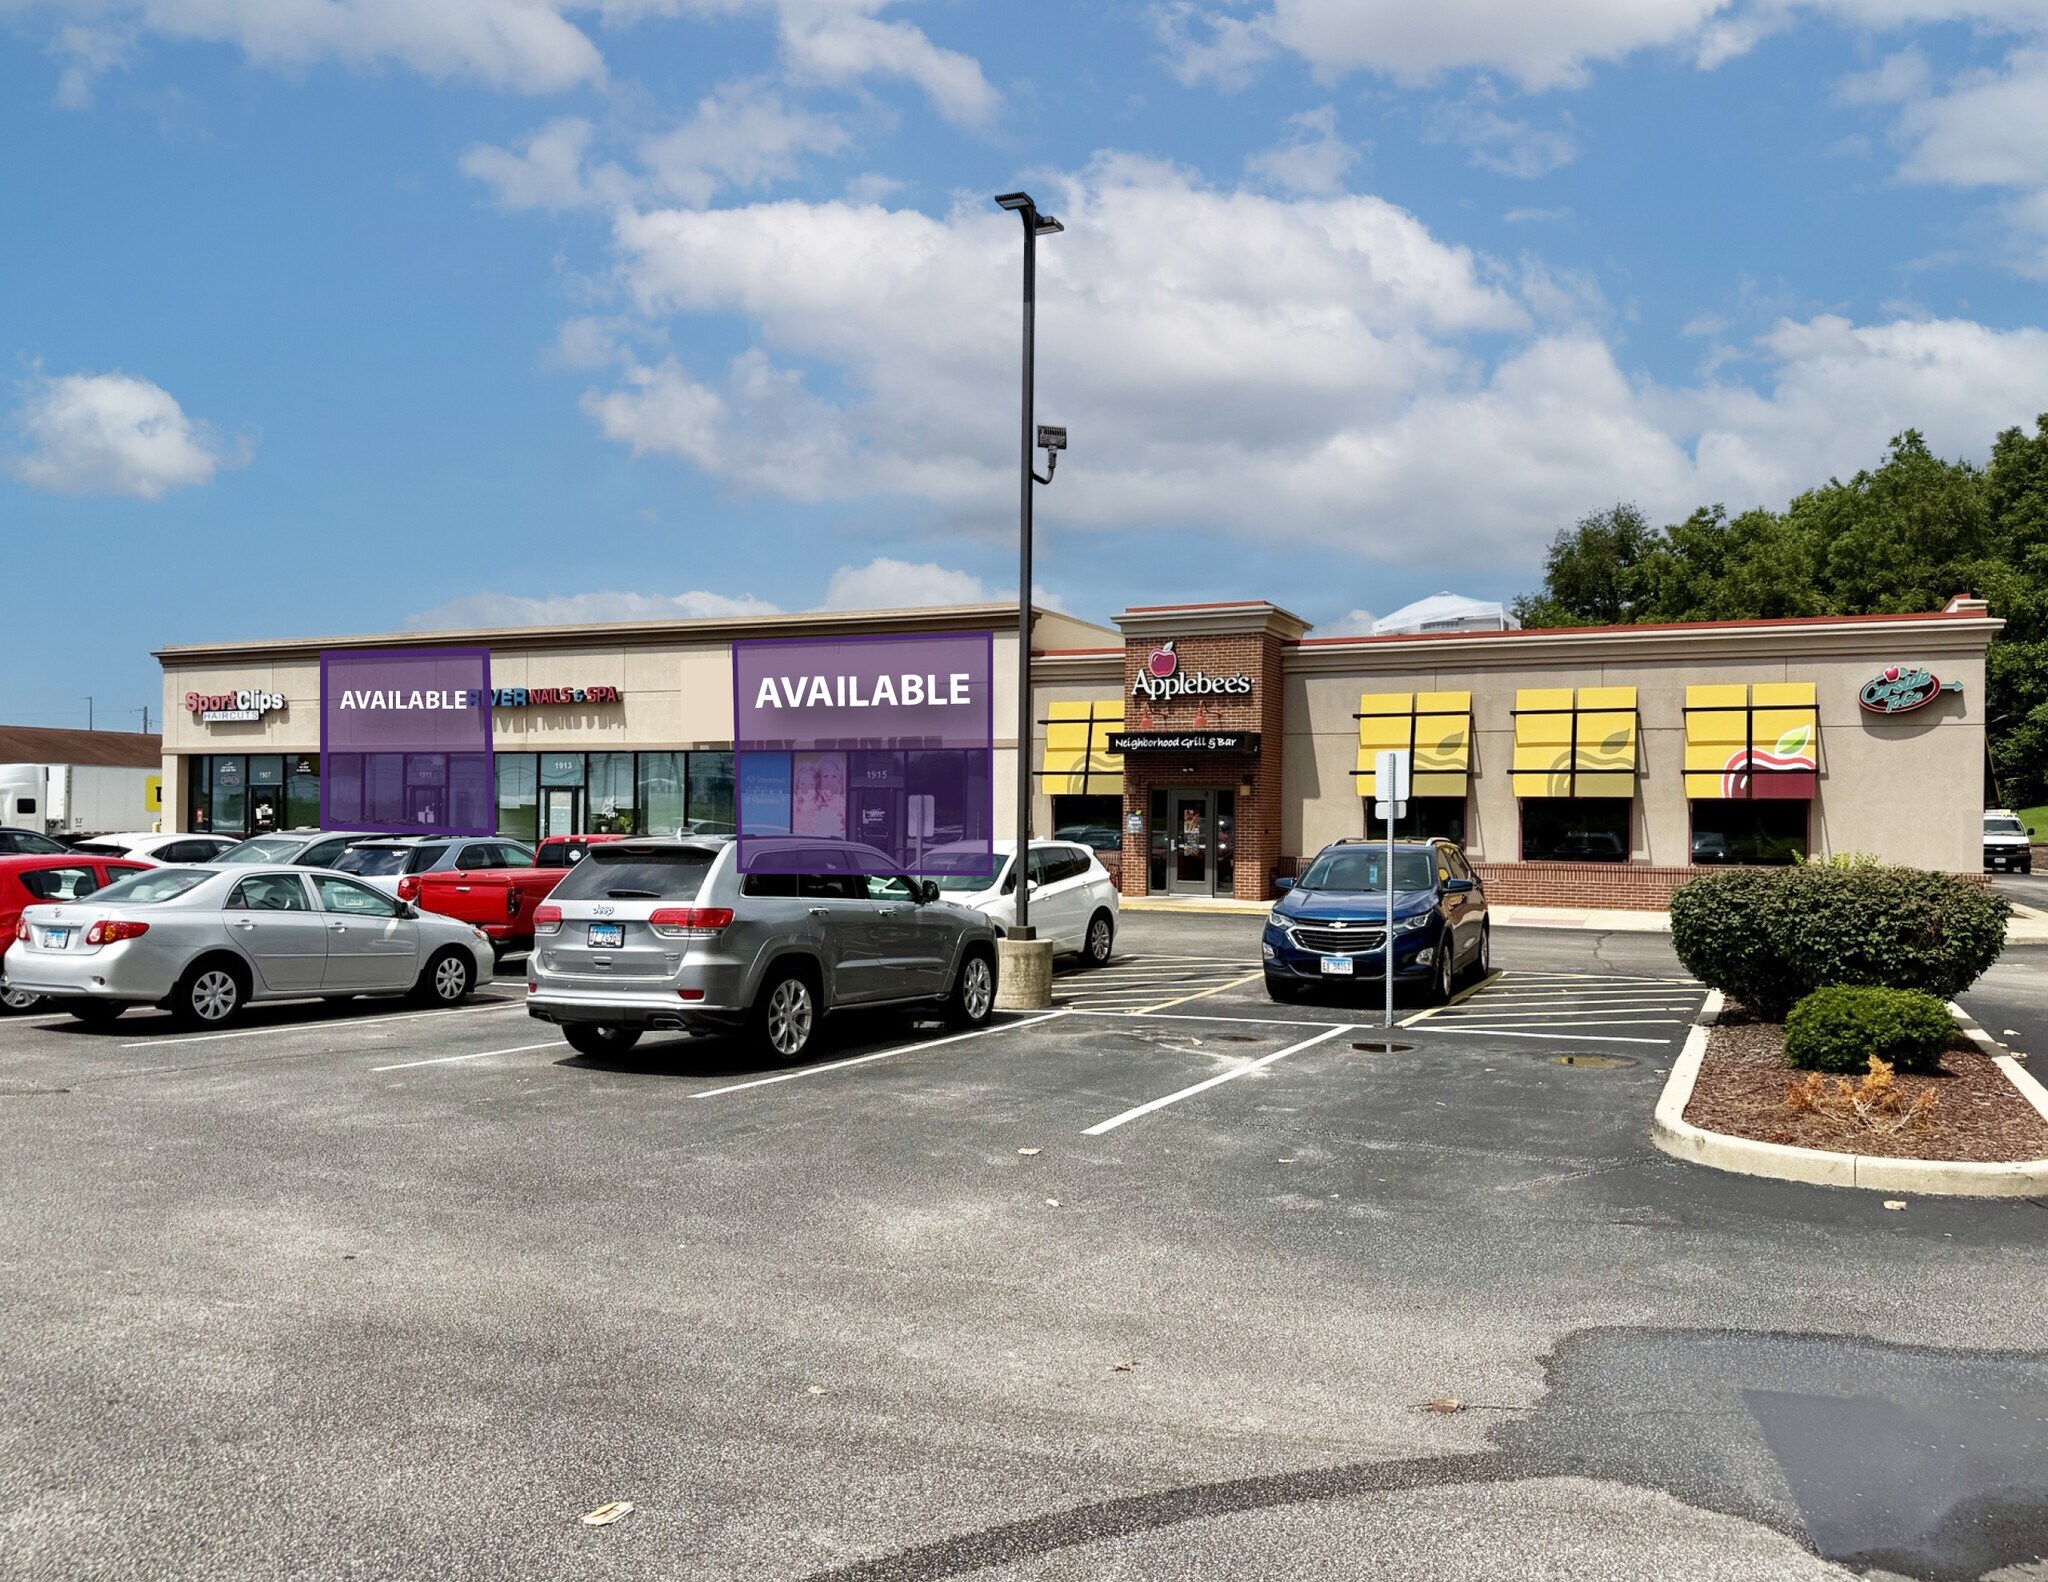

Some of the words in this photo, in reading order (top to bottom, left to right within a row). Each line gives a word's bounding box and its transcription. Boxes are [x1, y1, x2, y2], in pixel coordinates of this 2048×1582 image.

[1131, 668, 1251, 700] Applebee's
[531, 688, 571, 704] NAILS
[573, 689, 582, 703] &
[586, 687, 617, 703] SPA
[1885, 695, 1900, 713] To
[203, 711, 258, 720] HAIRCUTS
[1115, 737, 1180, 749] Neighborhood
[1181, 737, 1207, 748] Grill
[1217, 737, 1237, 746] Bar
[866, 770, 887, 779] 1915
[593, 905, 615, 916] Jeep
